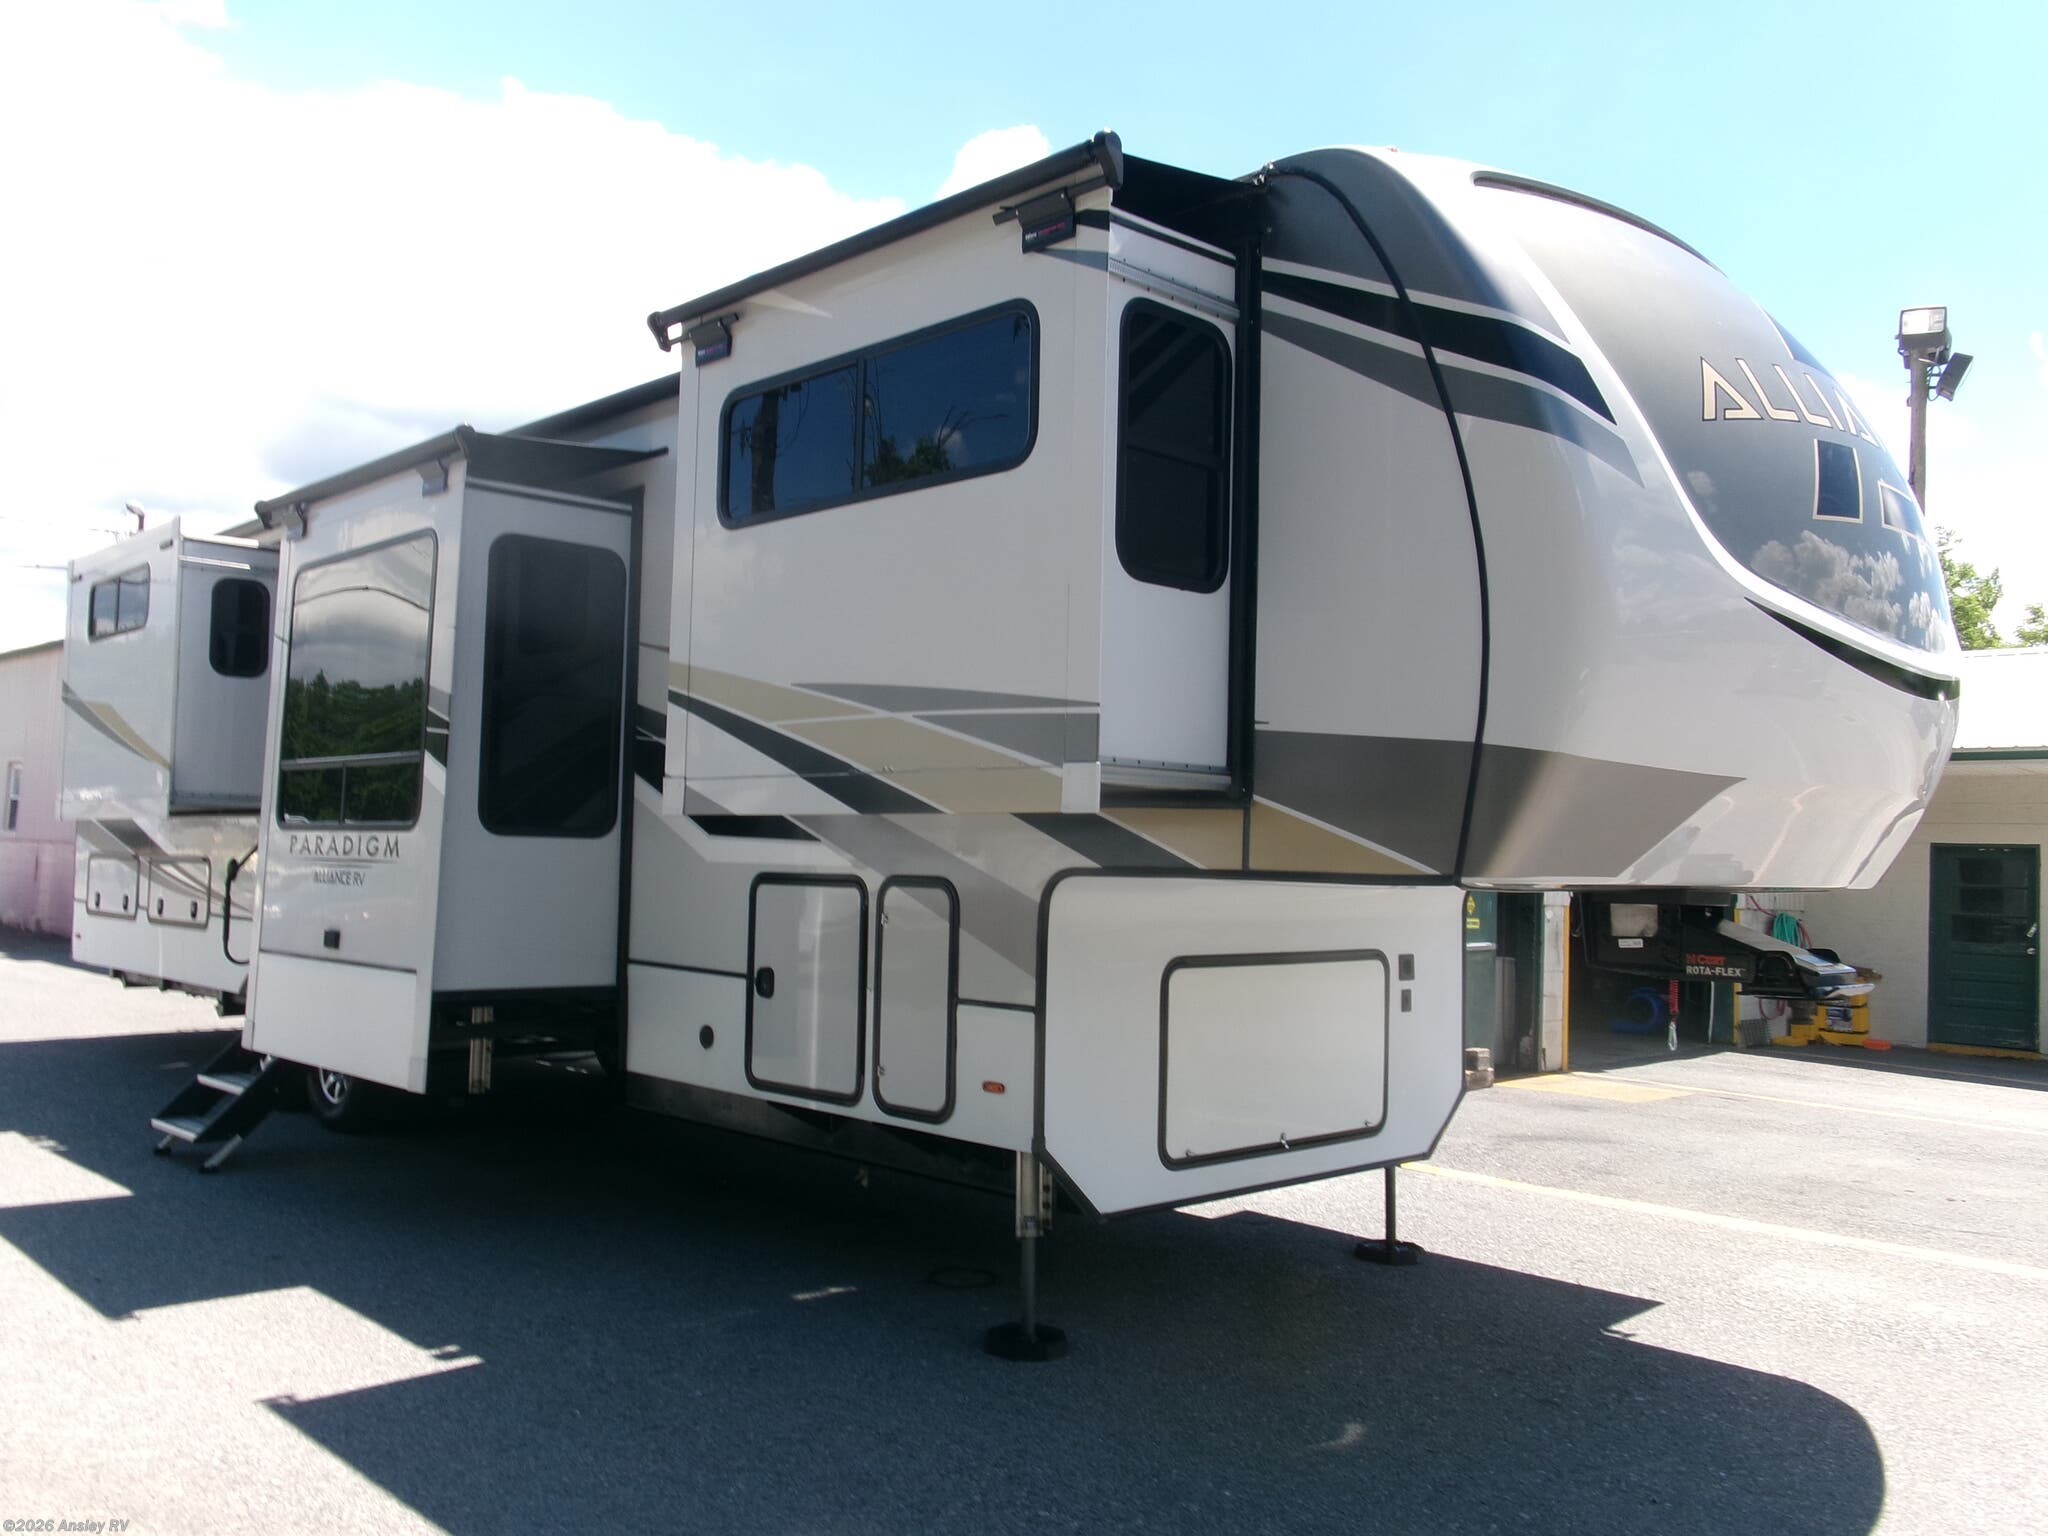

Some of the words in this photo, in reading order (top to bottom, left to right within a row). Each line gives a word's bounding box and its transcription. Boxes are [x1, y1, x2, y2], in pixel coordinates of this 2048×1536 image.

[289, 834, 400, 858] PARADIGM
[313, 870, 351, 884] ALLIANCE
[352, 873, 366, 886] RV
